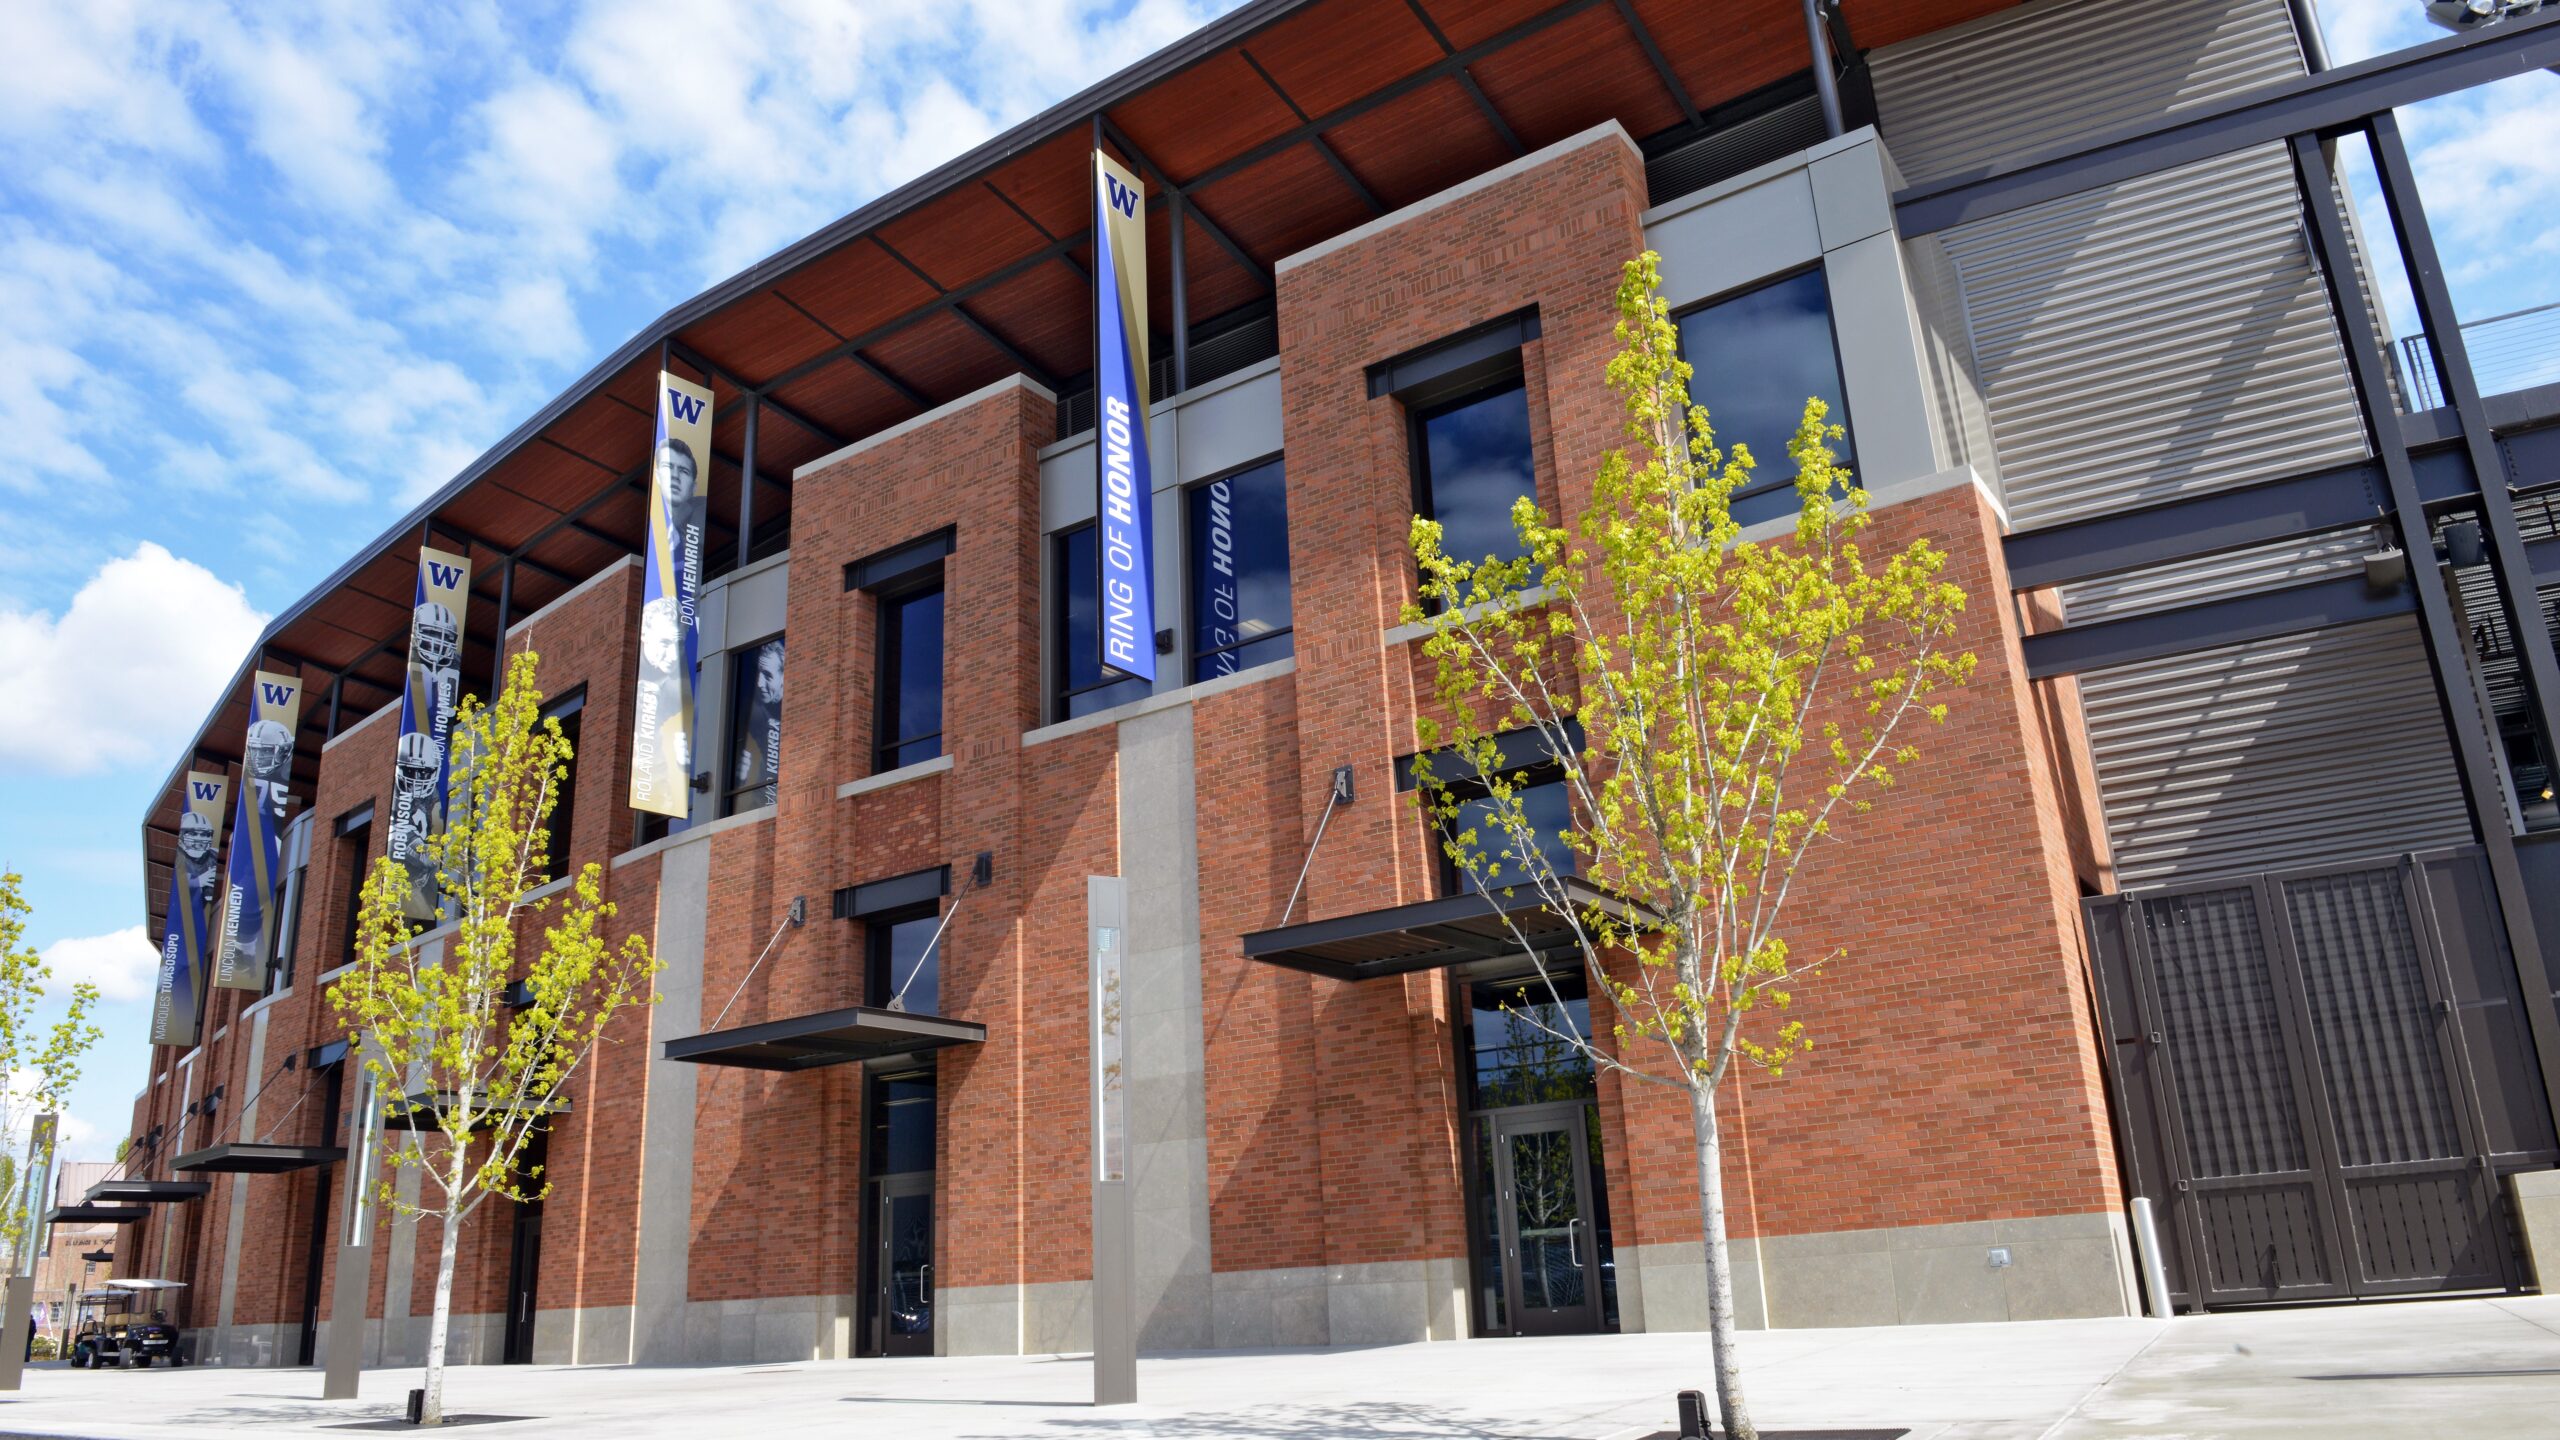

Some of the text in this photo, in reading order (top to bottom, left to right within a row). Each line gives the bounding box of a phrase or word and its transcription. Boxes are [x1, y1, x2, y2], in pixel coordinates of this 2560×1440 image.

[1104, 171, 1139, 219] W
[667, 387, 706, 425] W
[1106, 396, 1135, 663] RING OF HONOR
[427, 560, 464, 591] W
[680, 523, 700, 626] DON HEINRICH
[261, 682, 295, 707] W
[434, 682, 452, 733] HOLMES
[636, 682, 660, 801] ROLAND KIRKBY
[192, 781, 222, 802] W
[392, 791, 413, 860] ROBINSON
[220, 884, 244, 982] LINCOLN KENNEDY
[154, 933, 180, 1040] MARQUES TUIASOSOPO
